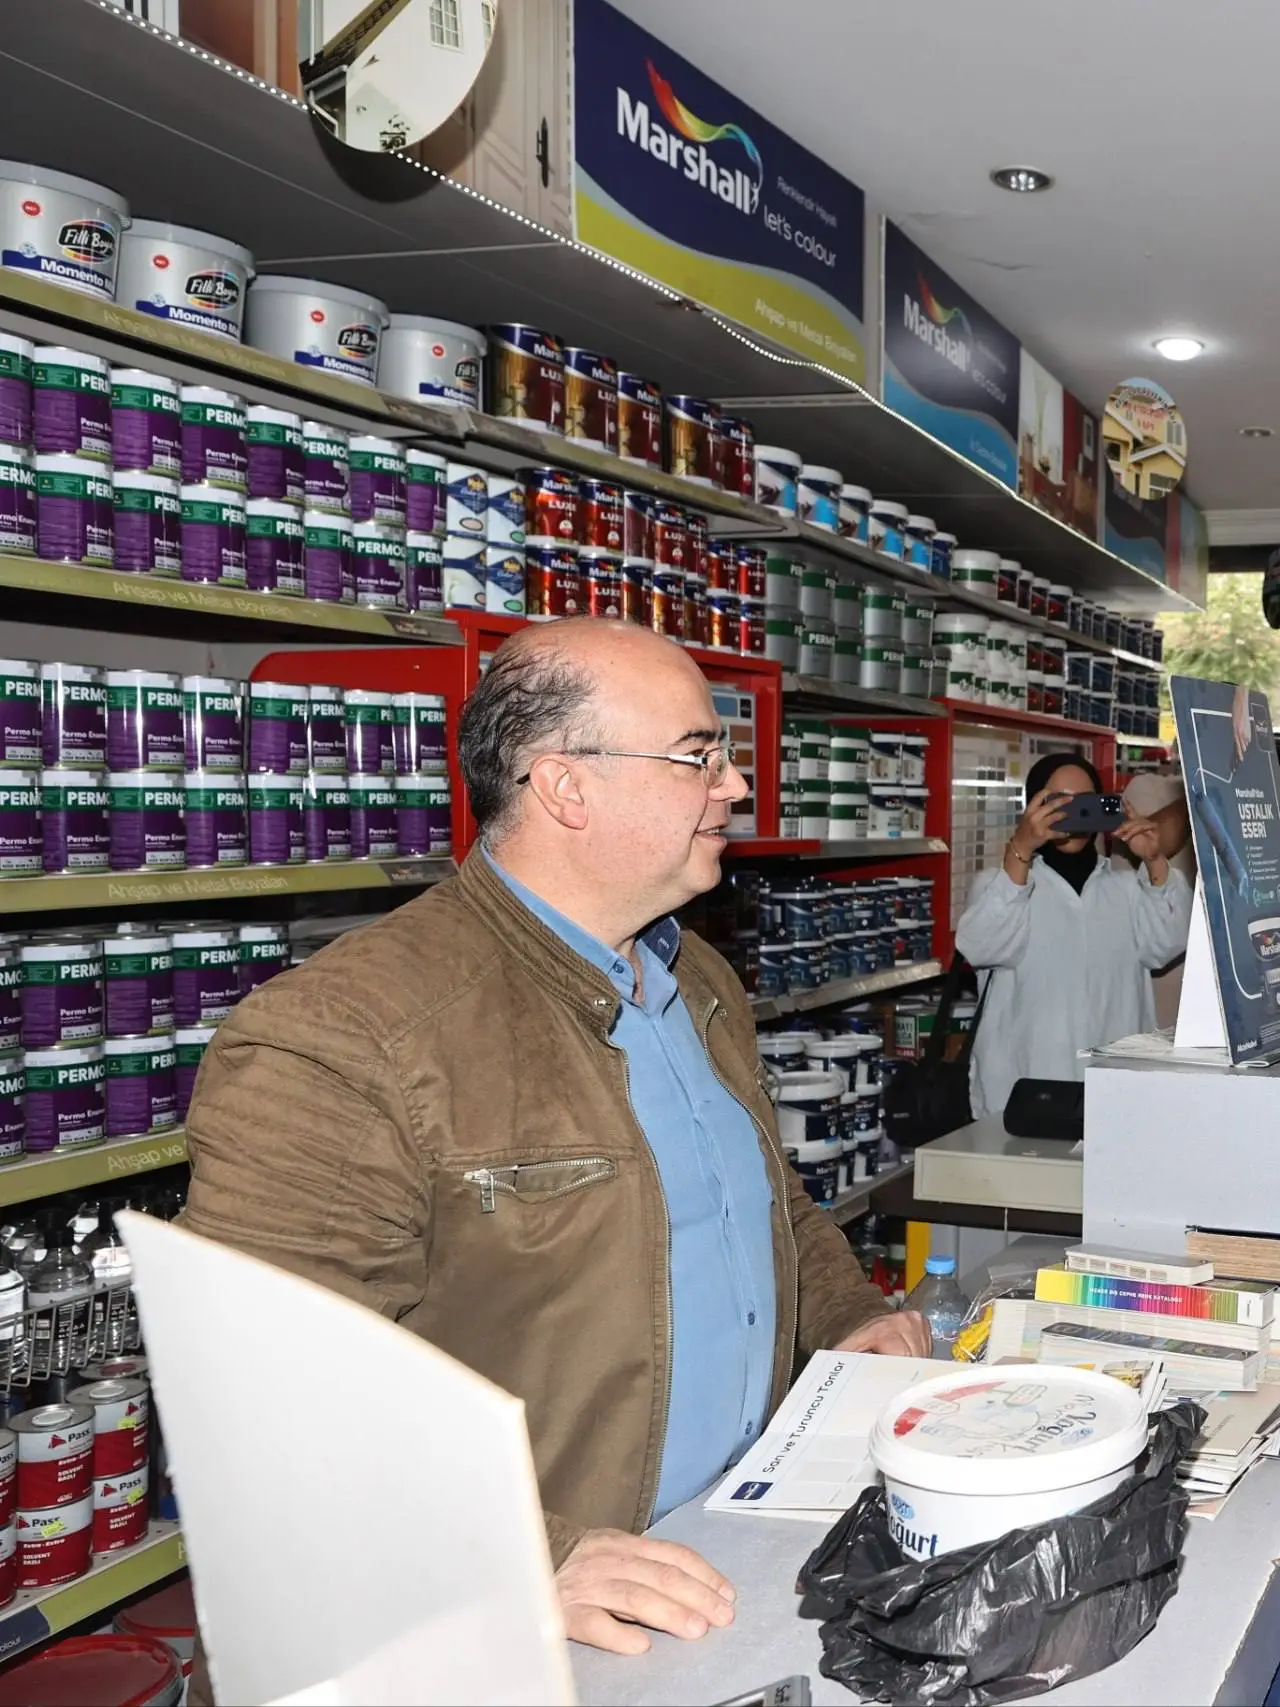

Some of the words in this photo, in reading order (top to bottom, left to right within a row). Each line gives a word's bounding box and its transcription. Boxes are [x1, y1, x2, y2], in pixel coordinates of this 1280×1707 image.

[617, 86, 750, 215] Marshall
[794, 231, 836, 268] colour
[41, 258, 103, 286] Momento
[169, 307, 228, 330] Momento
[904, 293, 968, 373] Marshall
[5, 726, 31, 737] Permo
[1238, 803, 1274, 820] USTALIK
[145, 834, 170, 843] Permo
[1241, 821, 1267, 838] ESERİ
[67, 835, 94, 845] Permo
[164, 882, 183, 896] ve
[60, 1007, 85, 1017] Permo
[58, 1112, 86, 1122] Permo
[107, 1150, 160, 1173] Ahşap
[164, 1144, 184, 1158] ve
[783, 1439, 796, 1453] ve
[790, 1395, 824, 1439] Turuncu
[817, 1360, 846, 1393] Tonlar
[890, 1516, 938, 1557] oğurt
